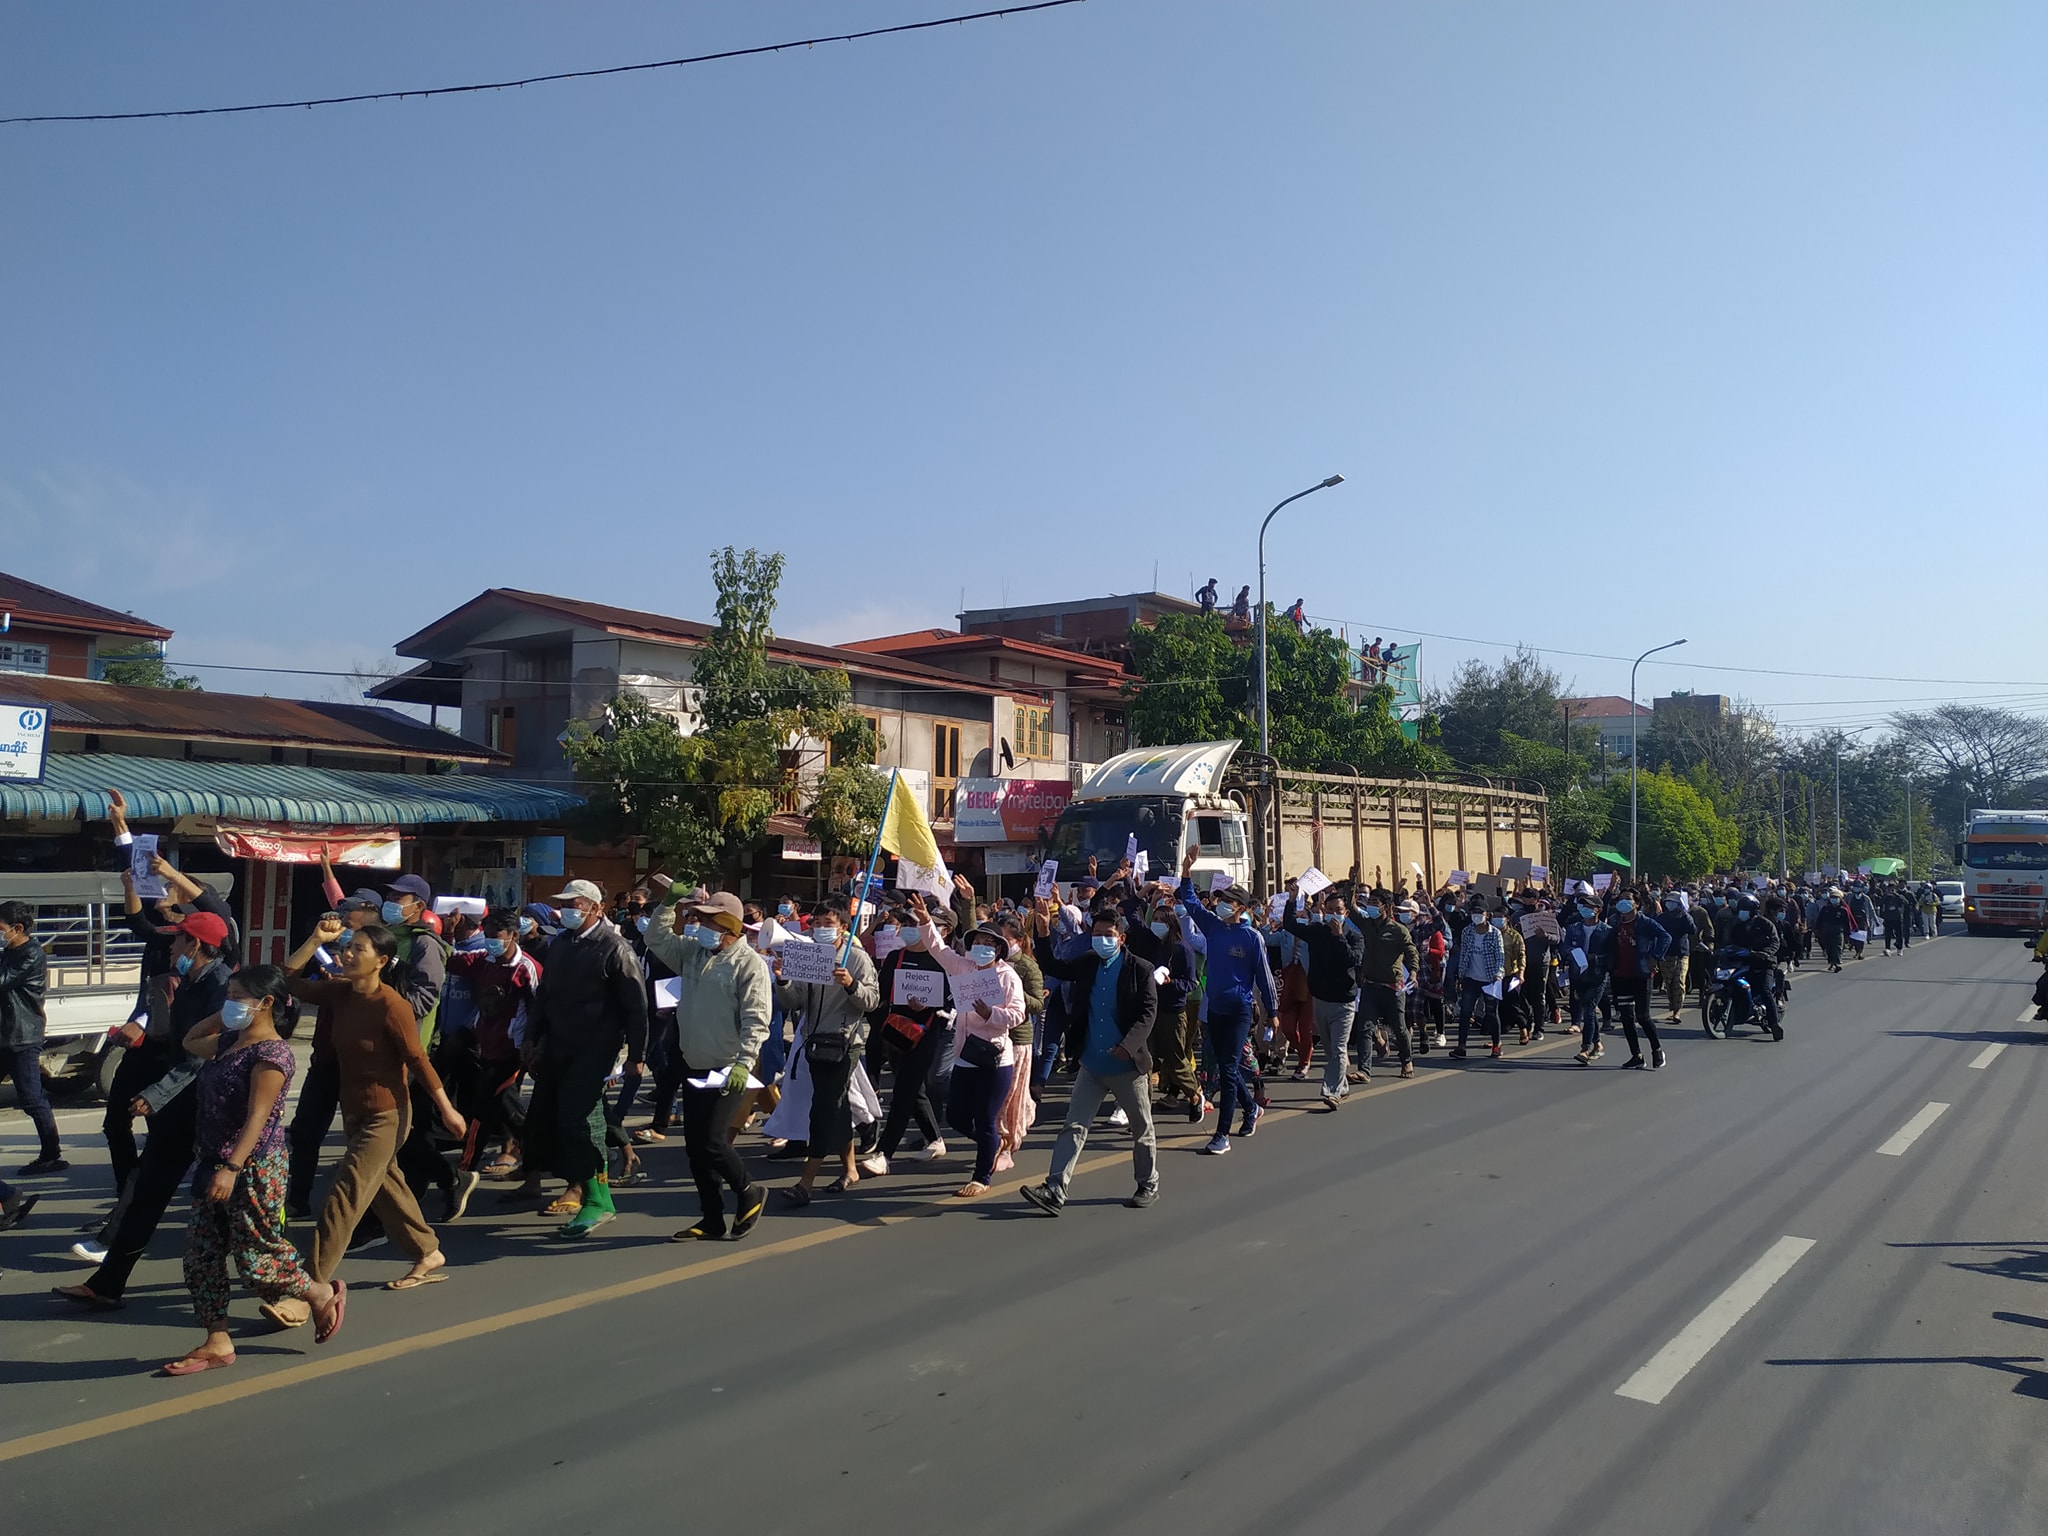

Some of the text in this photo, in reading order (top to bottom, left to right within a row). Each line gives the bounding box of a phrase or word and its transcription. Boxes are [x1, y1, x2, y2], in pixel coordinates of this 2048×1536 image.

[816, 954, 833, 964] Join
[781, 967, 832, 982] Dictatorship
[905, 971, 930, 981] Reject
[901, 982, 933, 993] Military
[906, 993, 928, 1003] Cup
